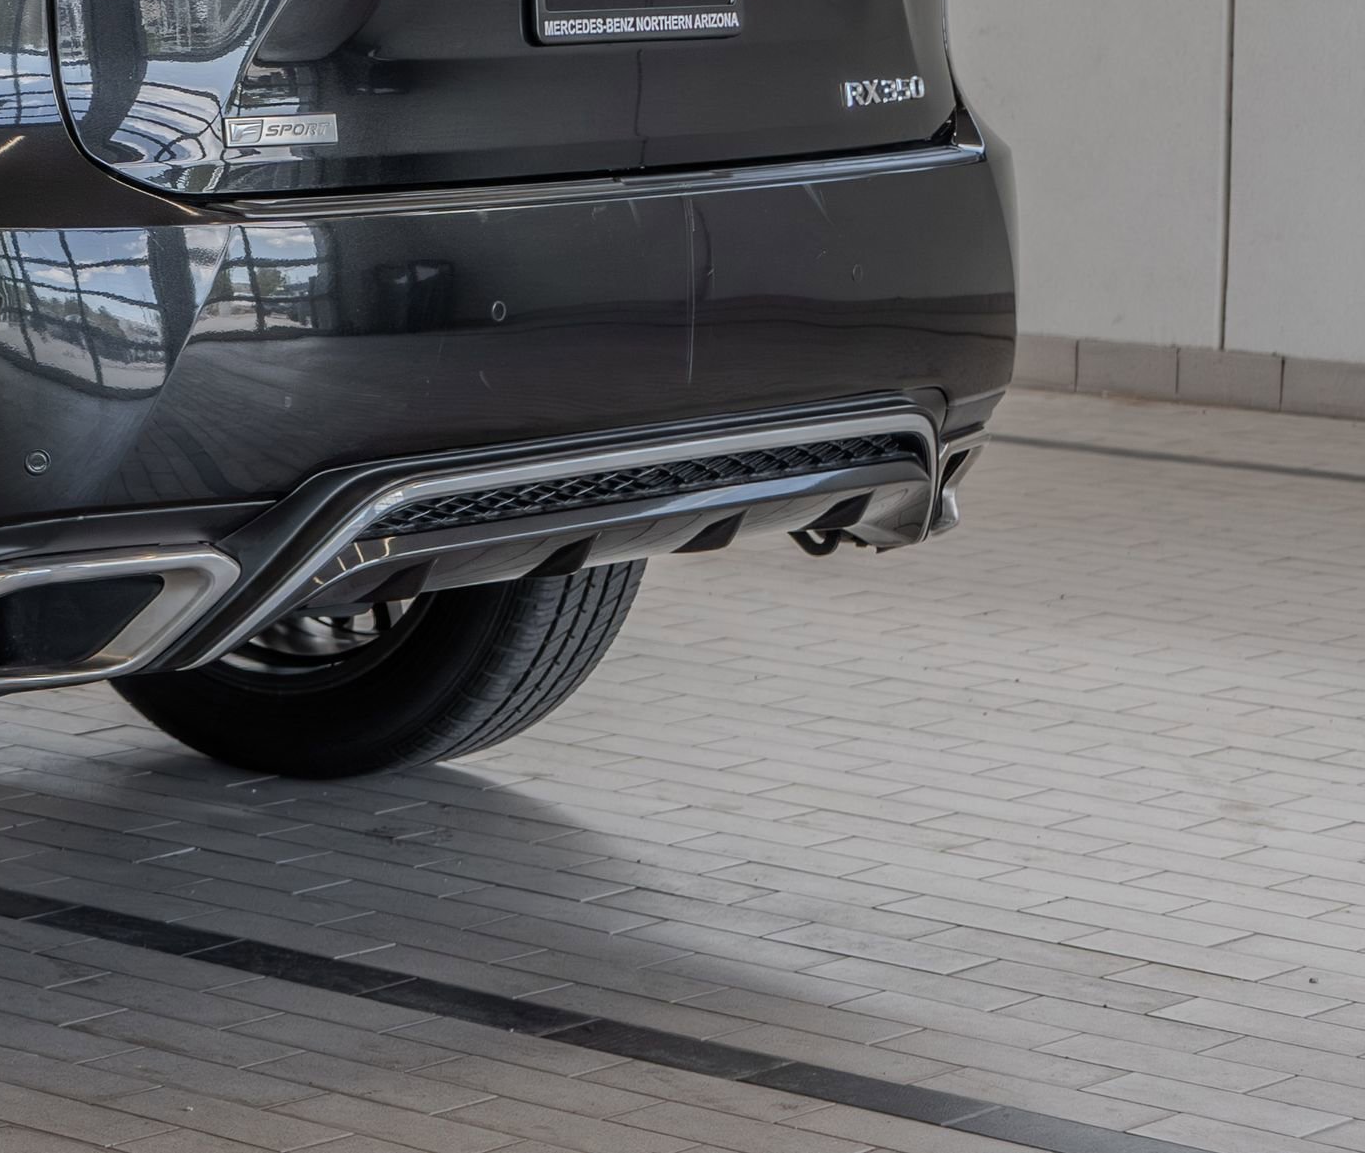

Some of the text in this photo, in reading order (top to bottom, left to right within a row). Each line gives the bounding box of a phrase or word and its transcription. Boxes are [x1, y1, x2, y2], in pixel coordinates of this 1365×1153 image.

[544, 12, 740, 36] MERCEDES-BENZ NORTHERN ARIZONA
[843, 75, 925, 107] RX350
[265, 121, 332, 137] SPORT
